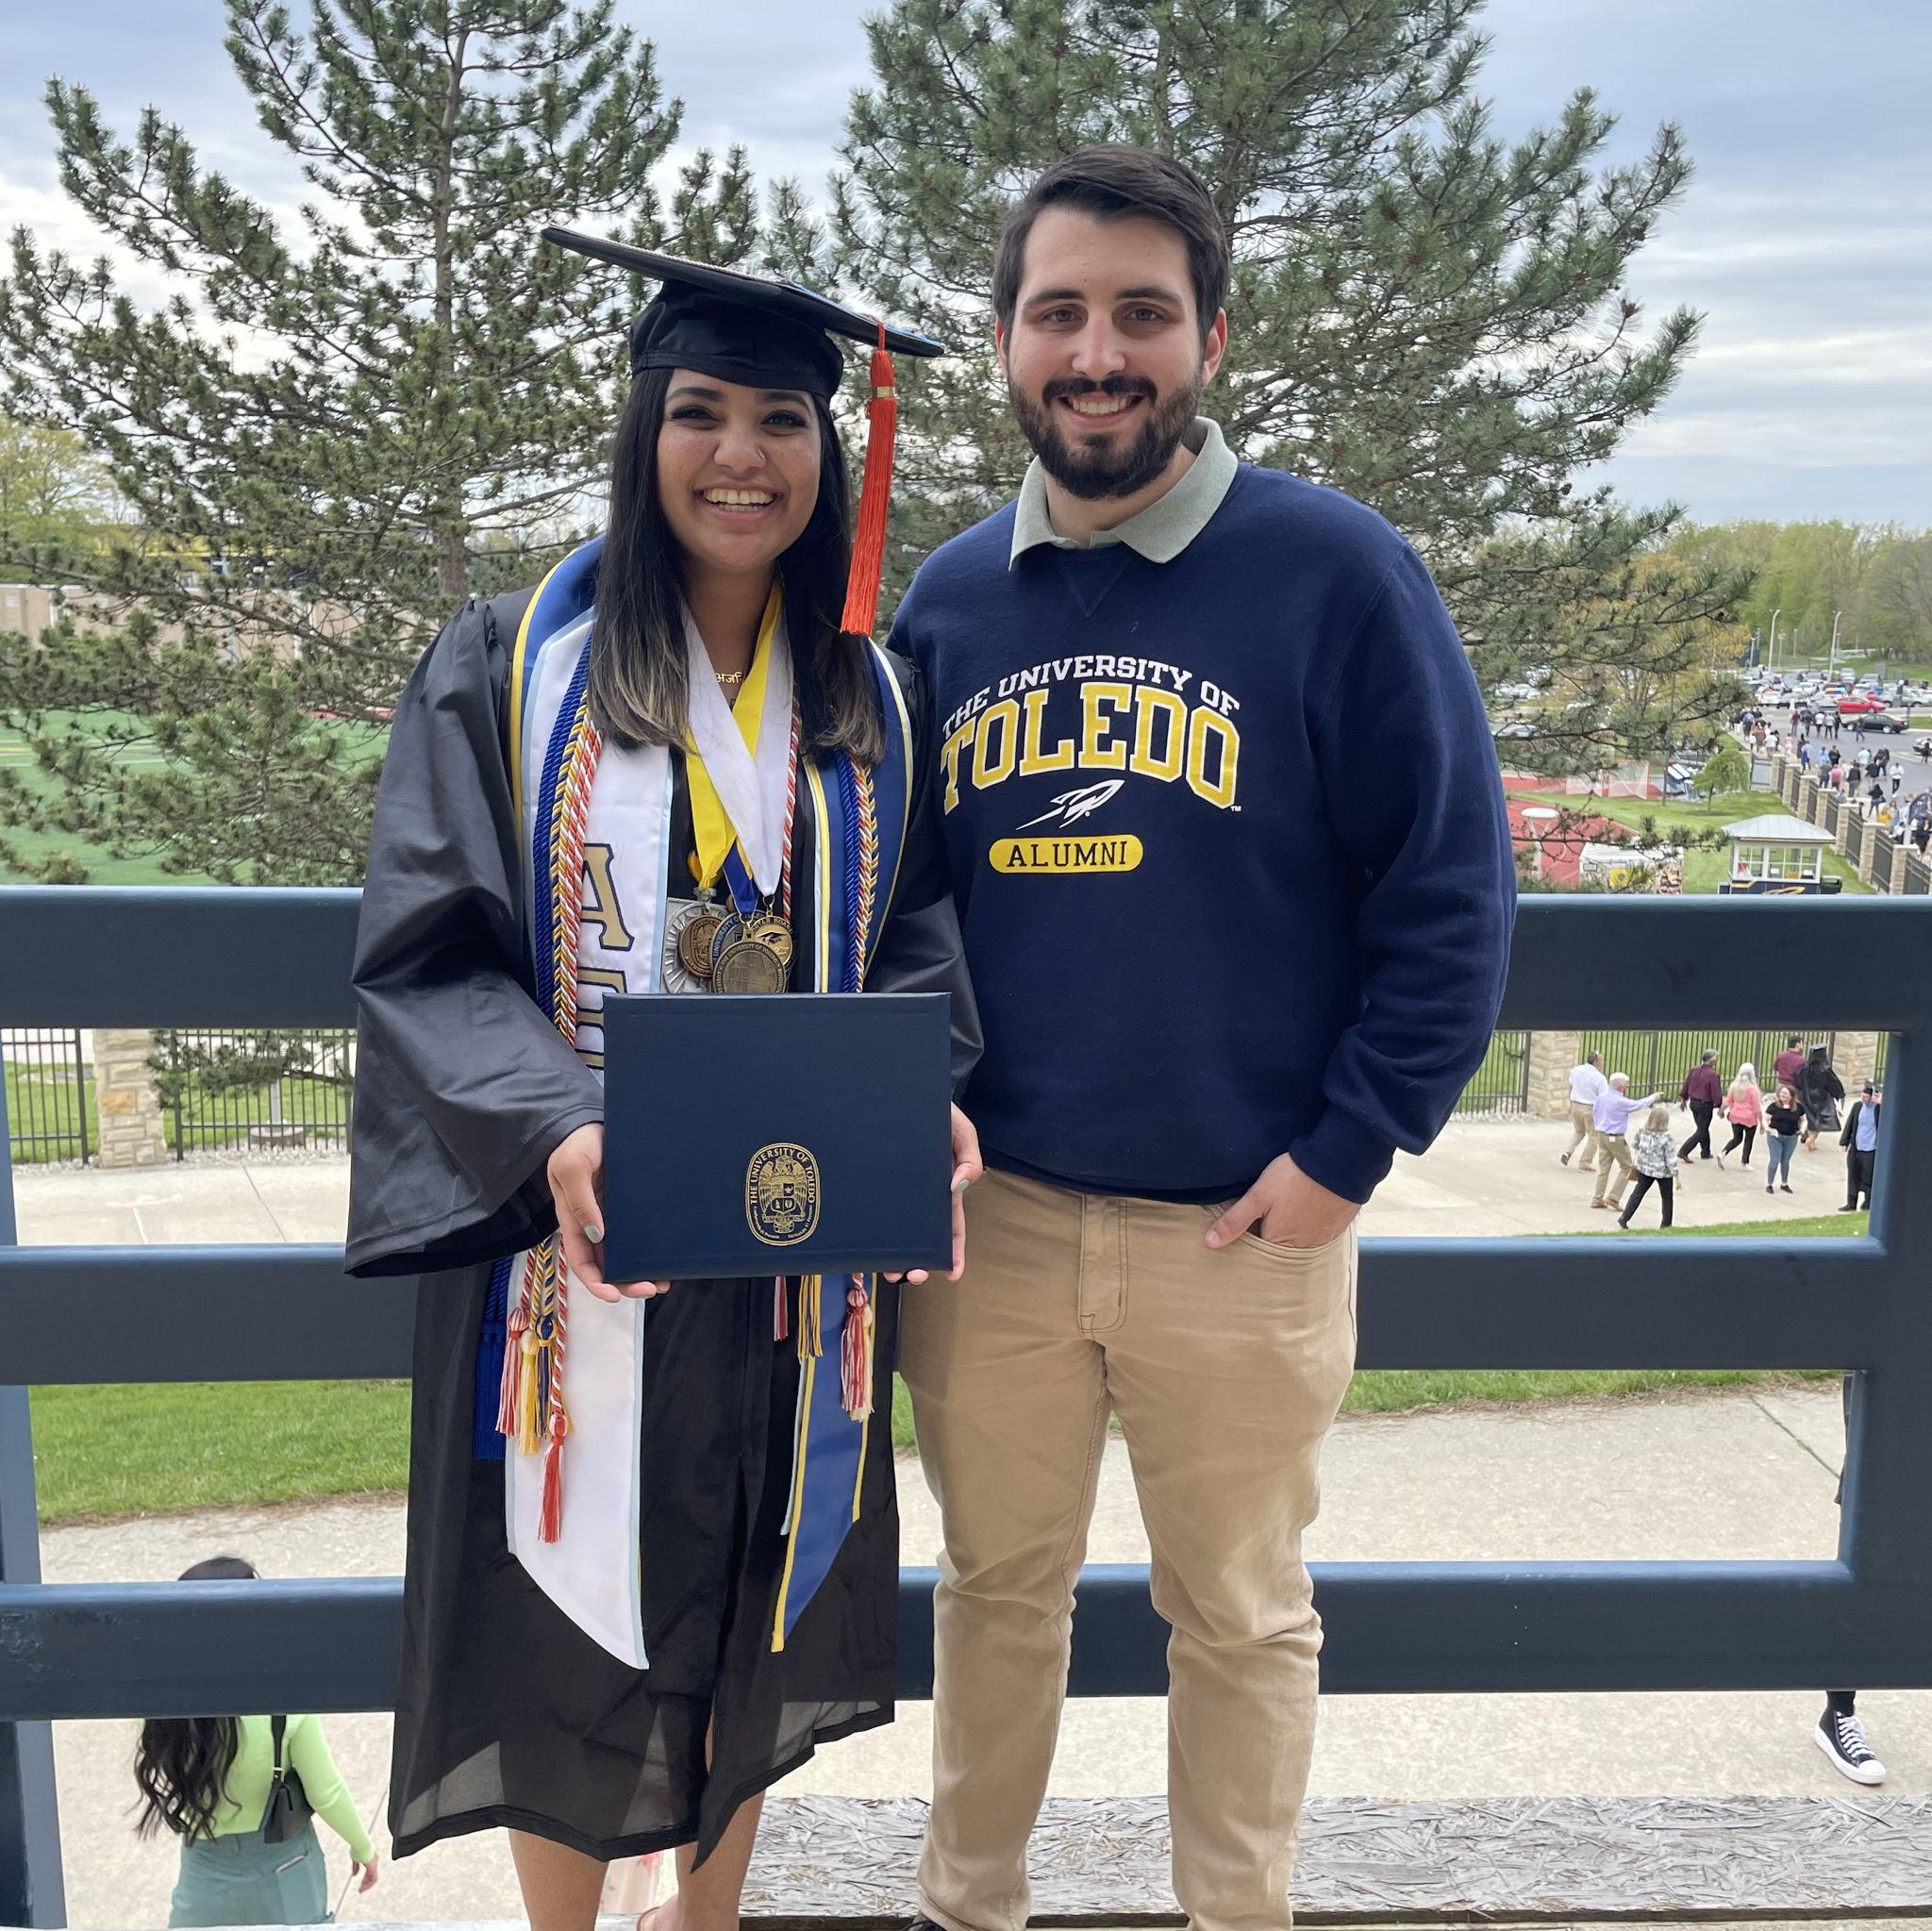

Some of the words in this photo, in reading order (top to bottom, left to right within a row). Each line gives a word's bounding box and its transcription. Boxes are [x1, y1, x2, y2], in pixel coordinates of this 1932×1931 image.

[942, 686, 991, 741] THE
[998, 655, 1192, 697] UNIVERSITY
[1200, 680, 1241, 716] OF
[940, 681, 1241, 816] TOLEDO
[1007, 841, 1127, 868] ALUMNI
[750, 1148, 795, 1183] UNIVERSITY
[796, 1152, 809, 1163] OF
[750, 1185, 758, 1205] THE
[806, 1165, 816, 1204] TOLEDO
